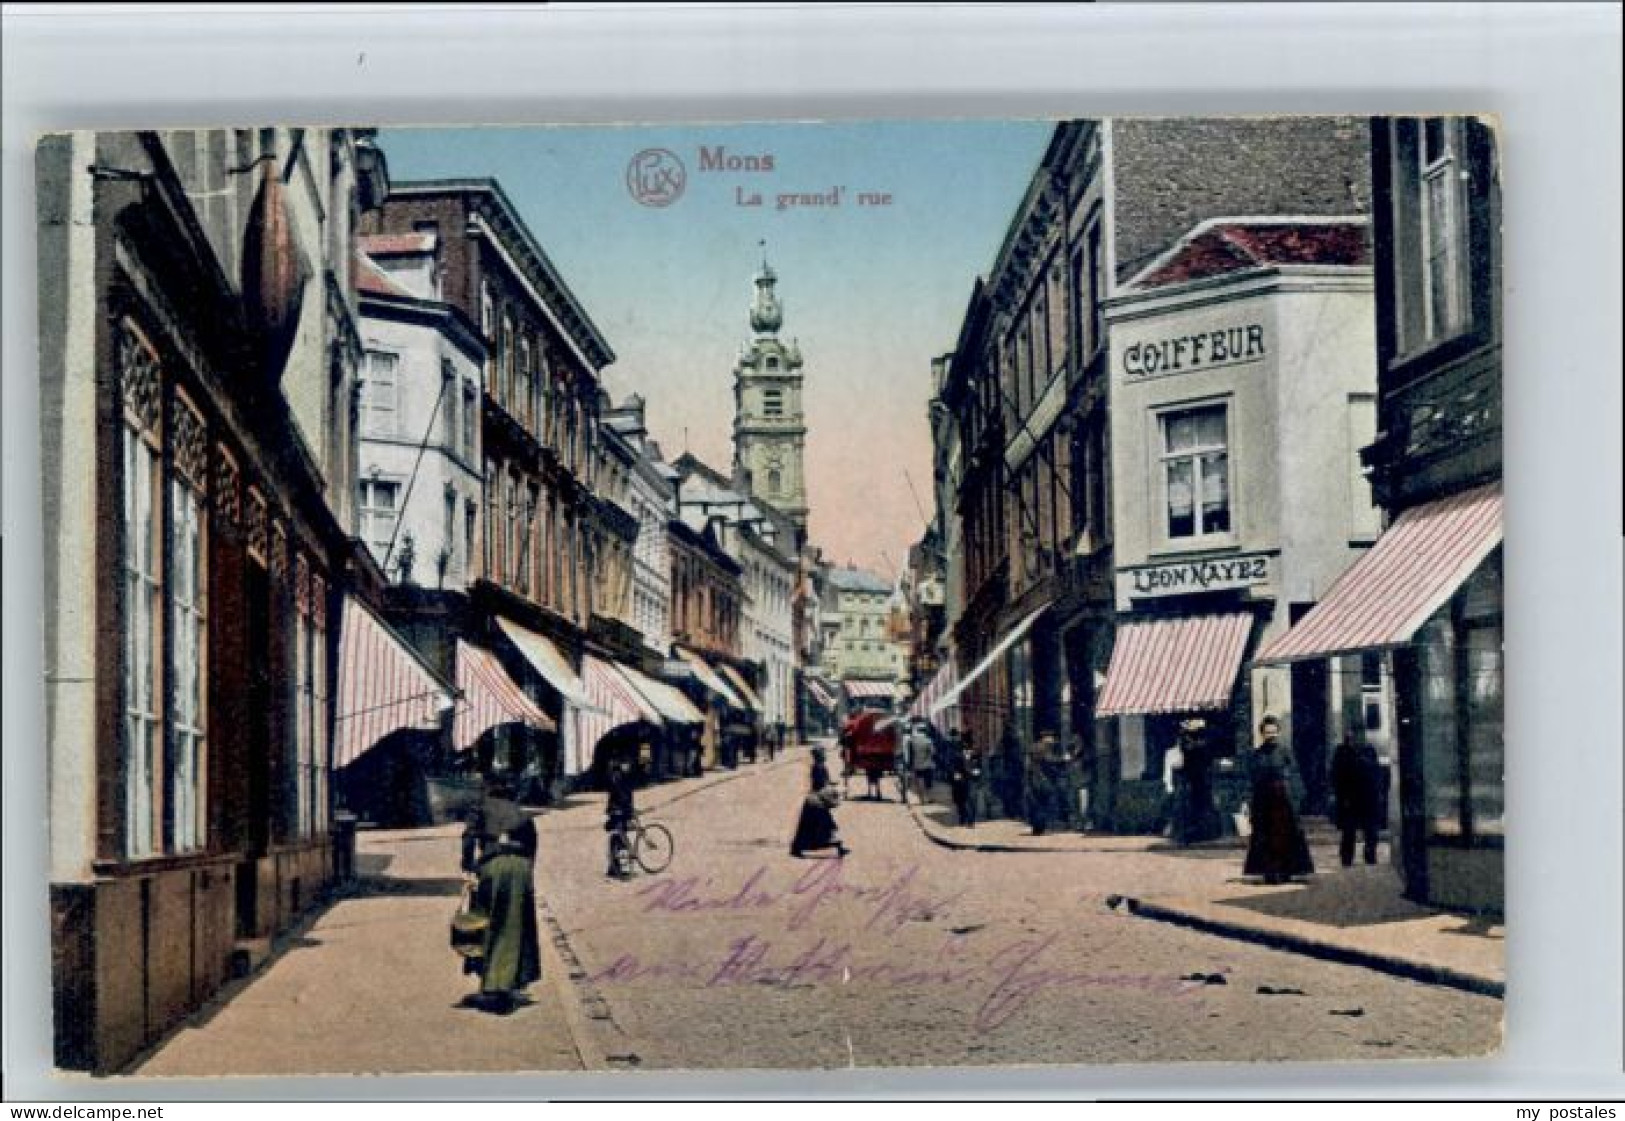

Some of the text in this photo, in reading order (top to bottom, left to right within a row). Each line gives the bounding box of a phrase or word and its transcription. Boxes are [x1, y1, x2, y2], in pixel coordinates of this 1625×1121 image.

[698, 145, 775, 172] Mons
[735, 185, 762, 206] La
[857, 192, 893, 206] rue
[1123, 323, 1265, 376] COIFFEUR
